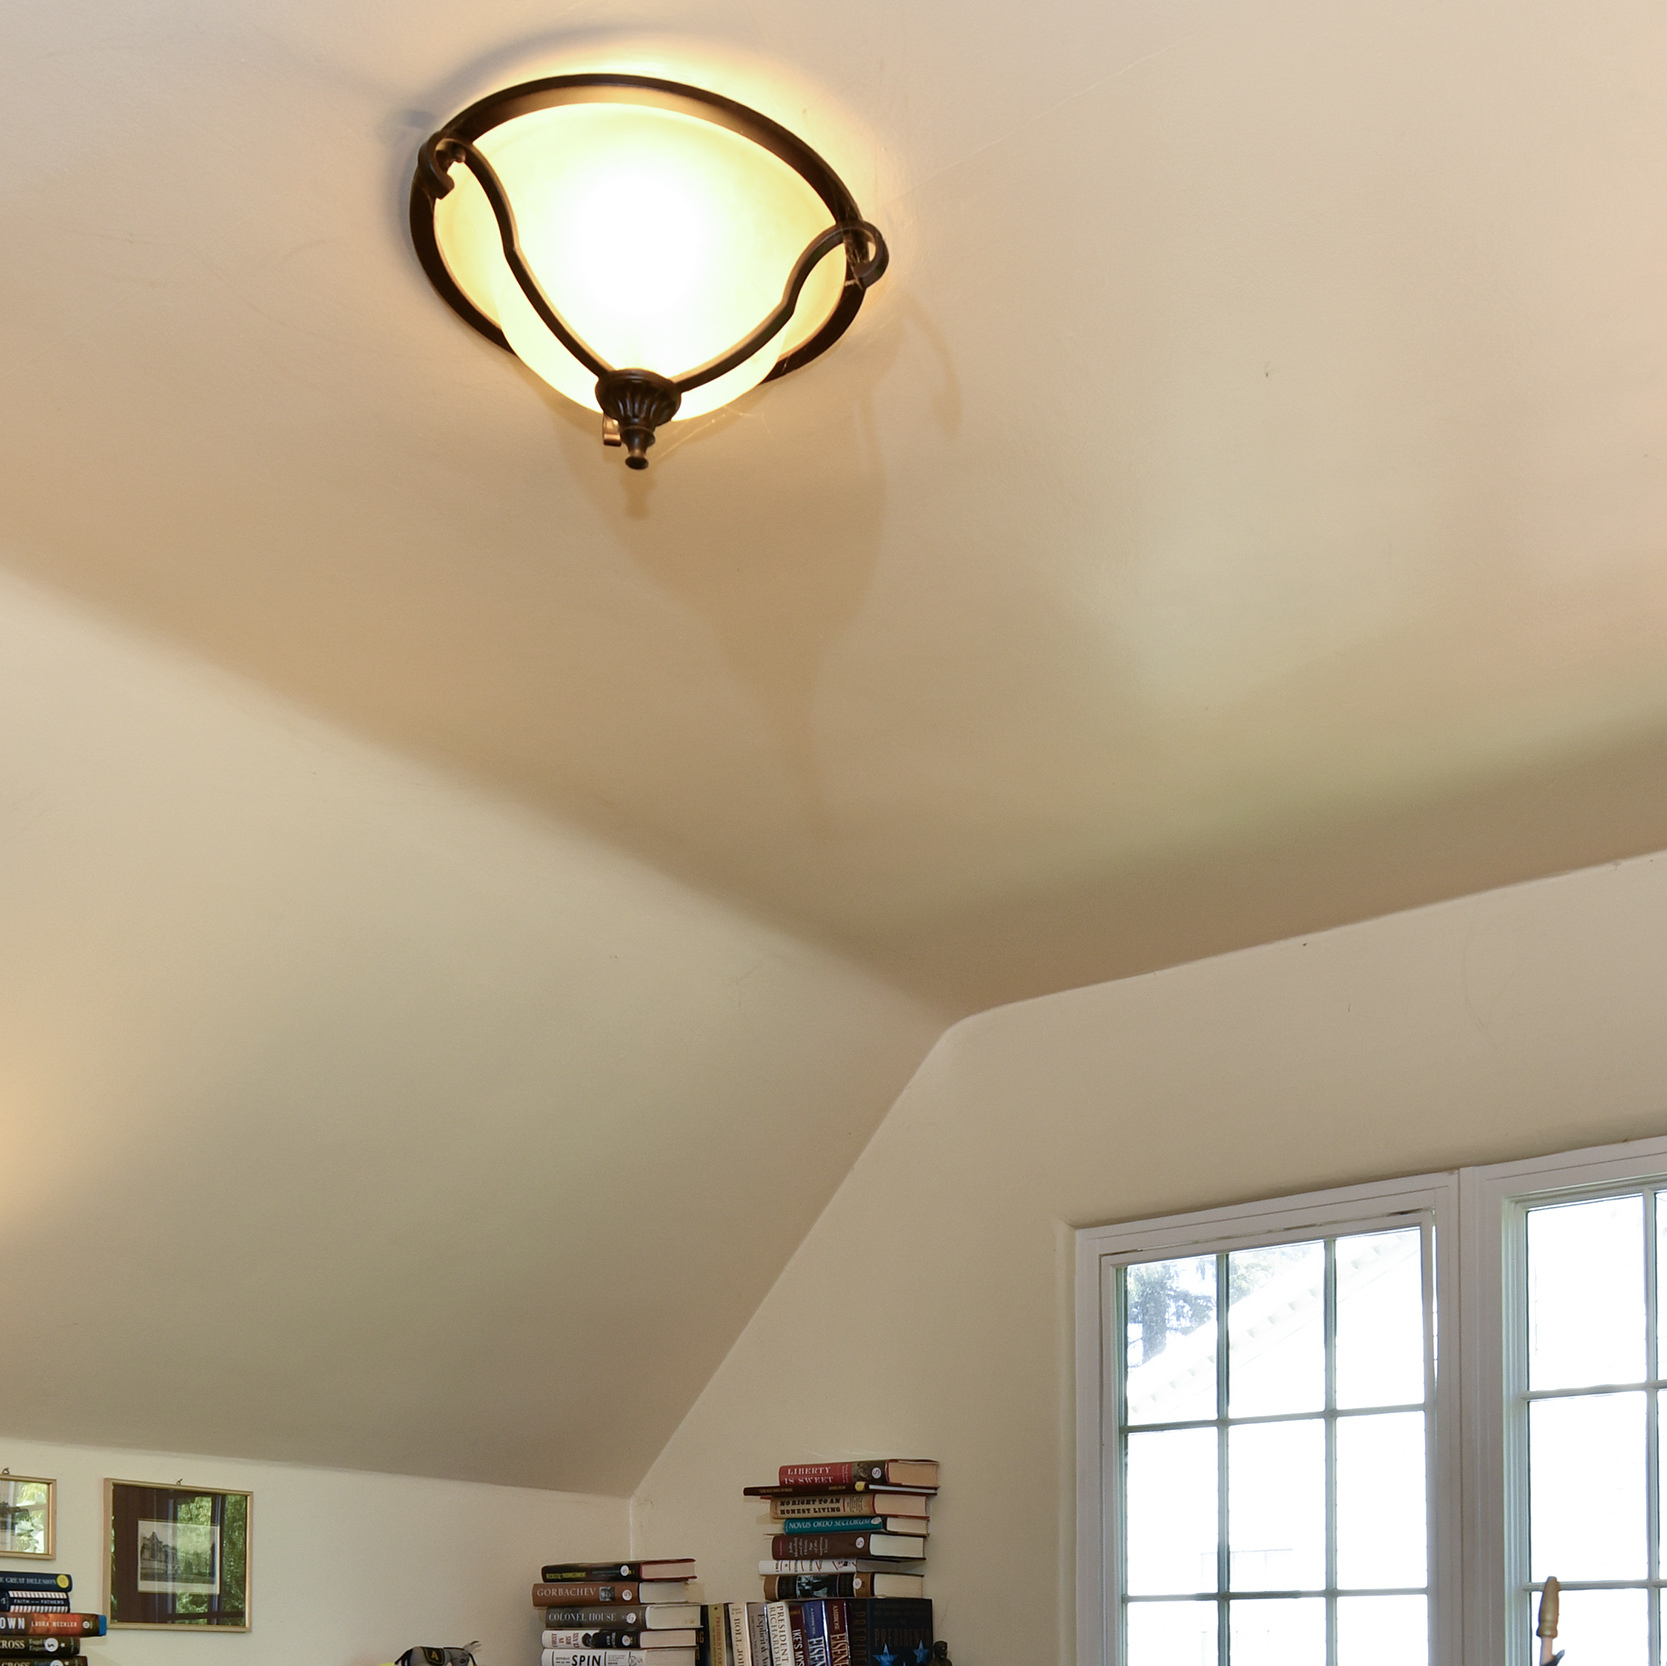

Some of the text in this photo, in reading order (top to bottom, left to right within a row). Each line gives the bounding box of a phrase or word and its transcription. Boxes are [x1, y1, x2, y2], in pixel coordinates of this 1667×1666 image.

[787, 1466, 831, 1475] LIBERTY
[798, 1476, 834, 1485] SWEET
[789, 1520, 812, 1530] NOVUS
[813, 1520, 834, 1528] ORDO
[25, 1577, 57, 1585] DELUSION
[536, 1588, 597, 1597] GORBACHEV
[40, 1598, 65, 1606] FATHERS
[548, 1612, 616, 1622] COLONEL HOUSE
[51, 1621, 78, 1629] MECKLER
[776, 1605, 790, 1663] PRESIDENT
[431, 1650, 439, 1661] A
[571, 1654, 601, 1666] SPIN
